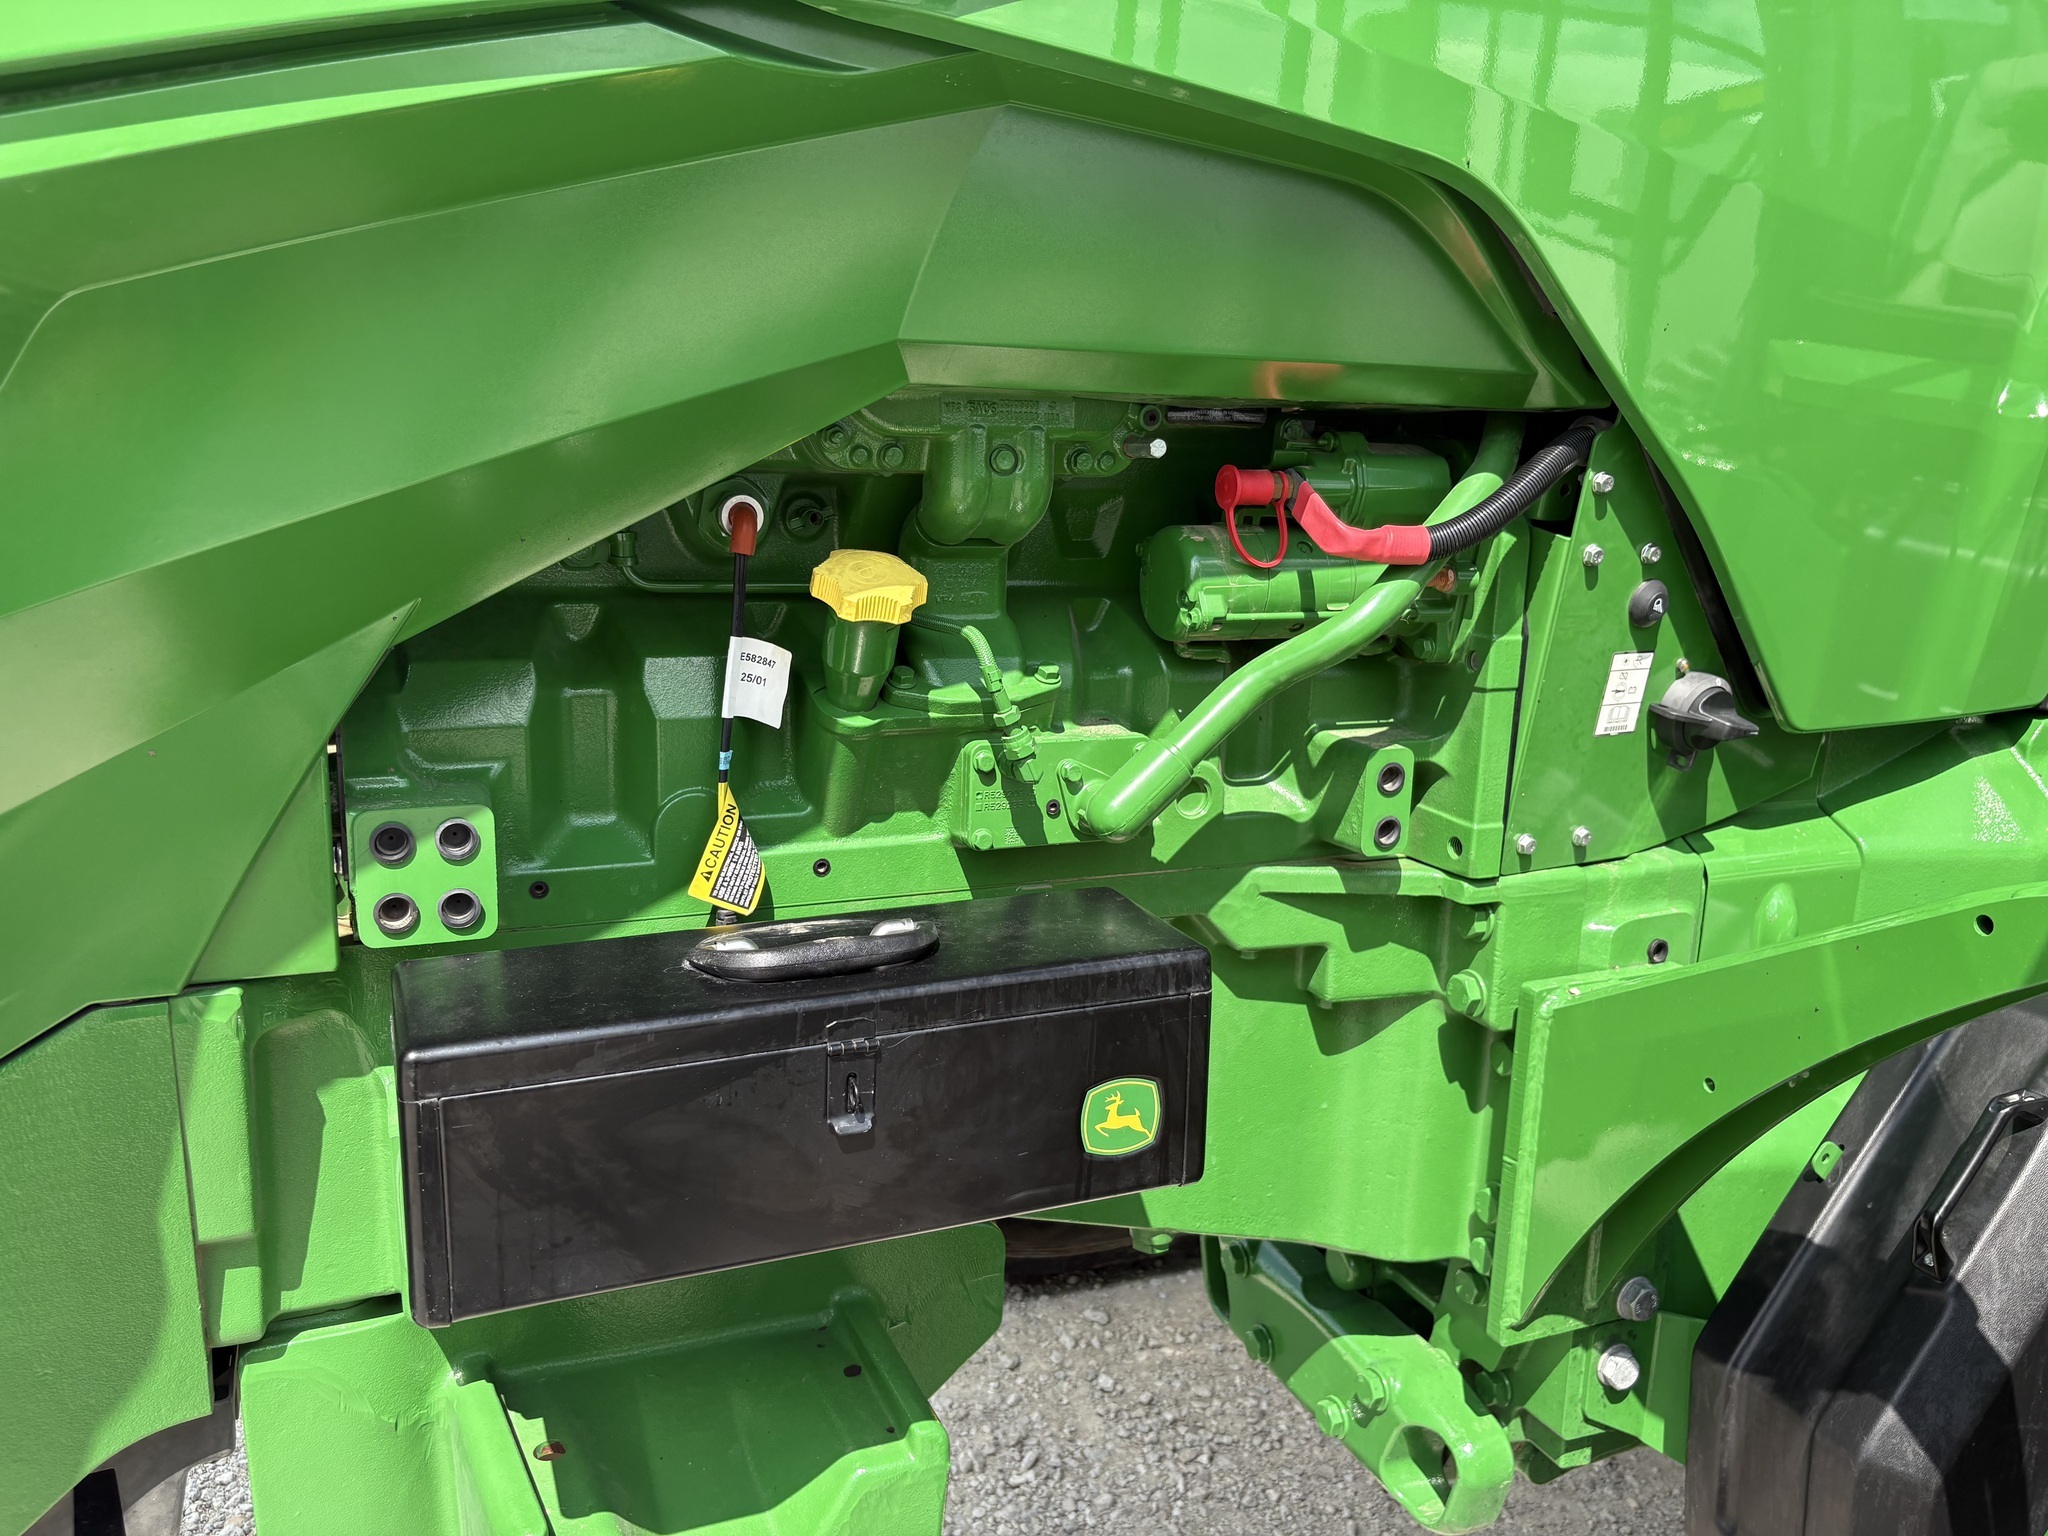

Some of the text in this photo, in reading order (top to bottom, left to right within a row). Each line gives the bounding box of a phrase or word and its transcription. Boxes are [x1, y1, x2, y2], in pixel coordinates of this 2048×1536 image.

[740, 652, 777, 669] E582847
[740, 672, 767, 687] 25/01
[705, 803, 737, 869] CAUTION
